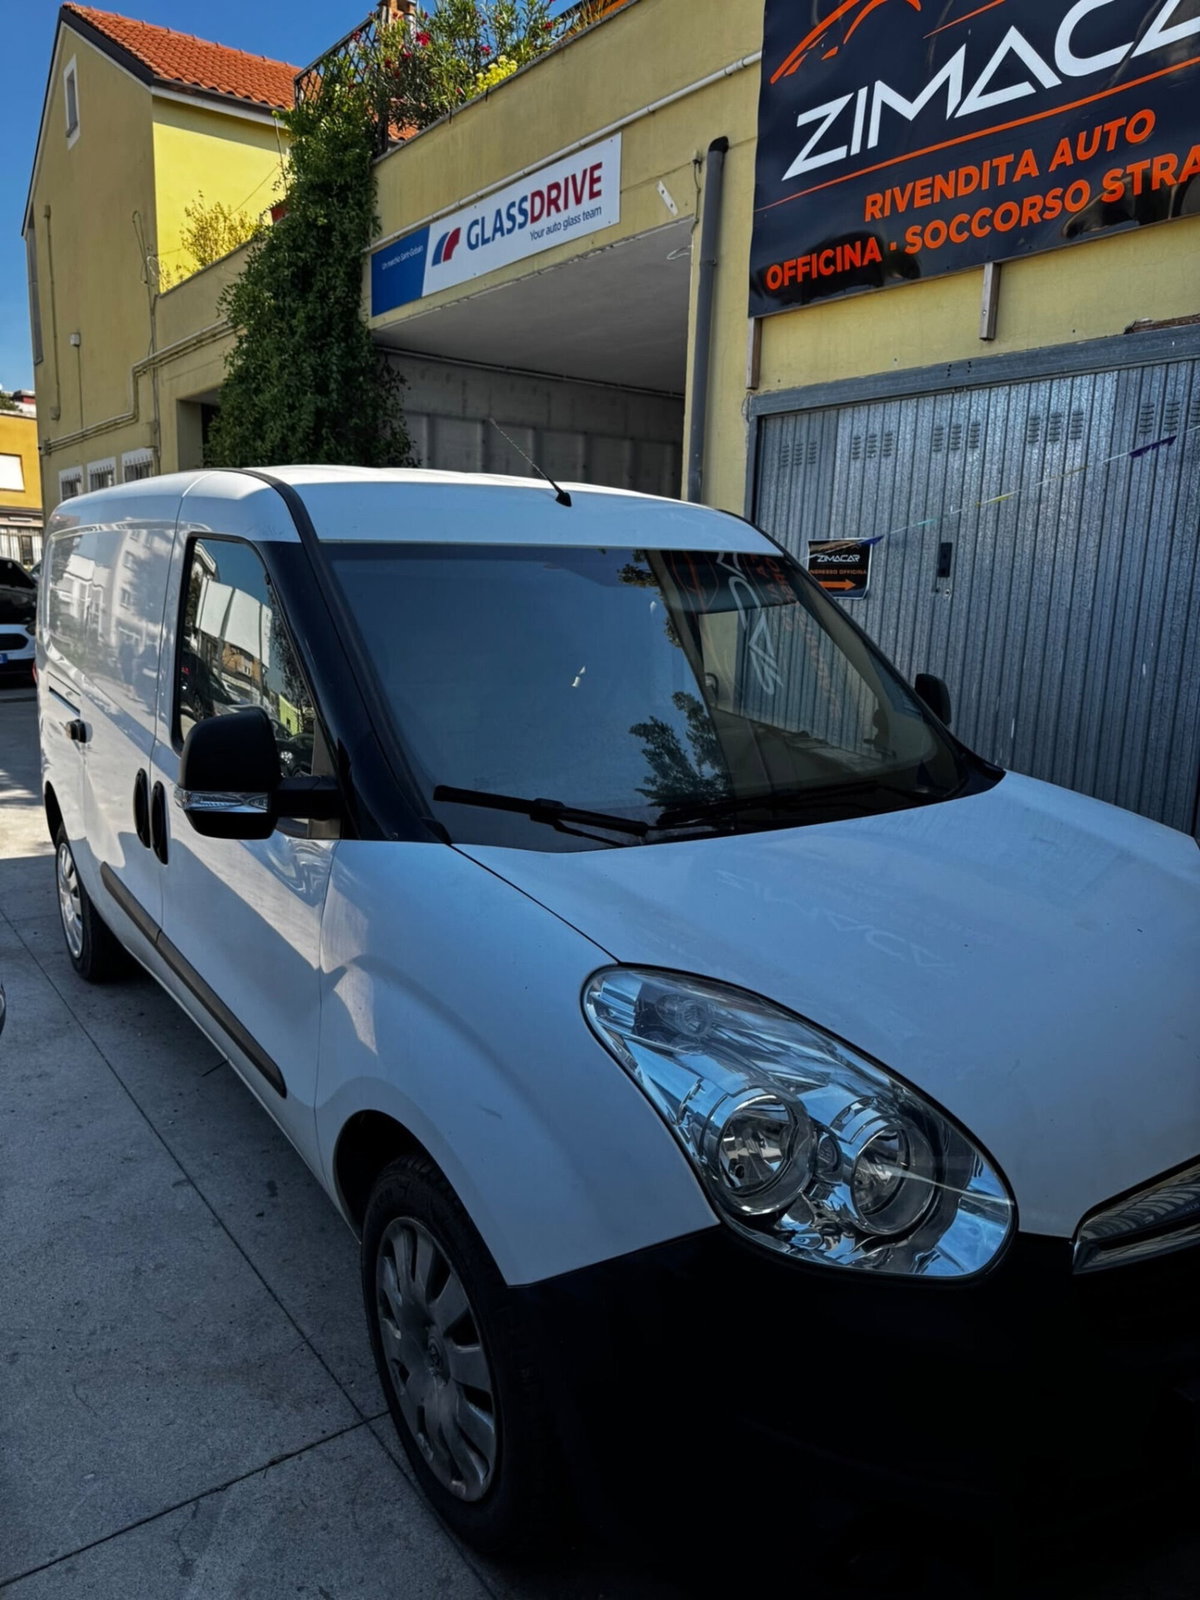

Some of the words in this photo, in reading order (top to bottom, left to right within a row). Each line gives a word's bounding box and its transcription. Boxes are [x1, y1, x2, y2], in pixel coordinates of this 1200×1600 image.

[466, 161, 603, 250] GLASSDRIVE
[864, 148, 1039, 222] RIVENDITA
[1049, 109, 1157, 172] AUTO
[530, 228, 545, 241] Your
[546, 221, 562, 236] auto
[563, 213, 581, 231] glass
[582, 206, 602, 222] team
[766, 236, 883, 291] OFFICINA
[904, 179, 1091, 255] SOCCORSO
[817, 554, 860, 562] ZIMACAR
